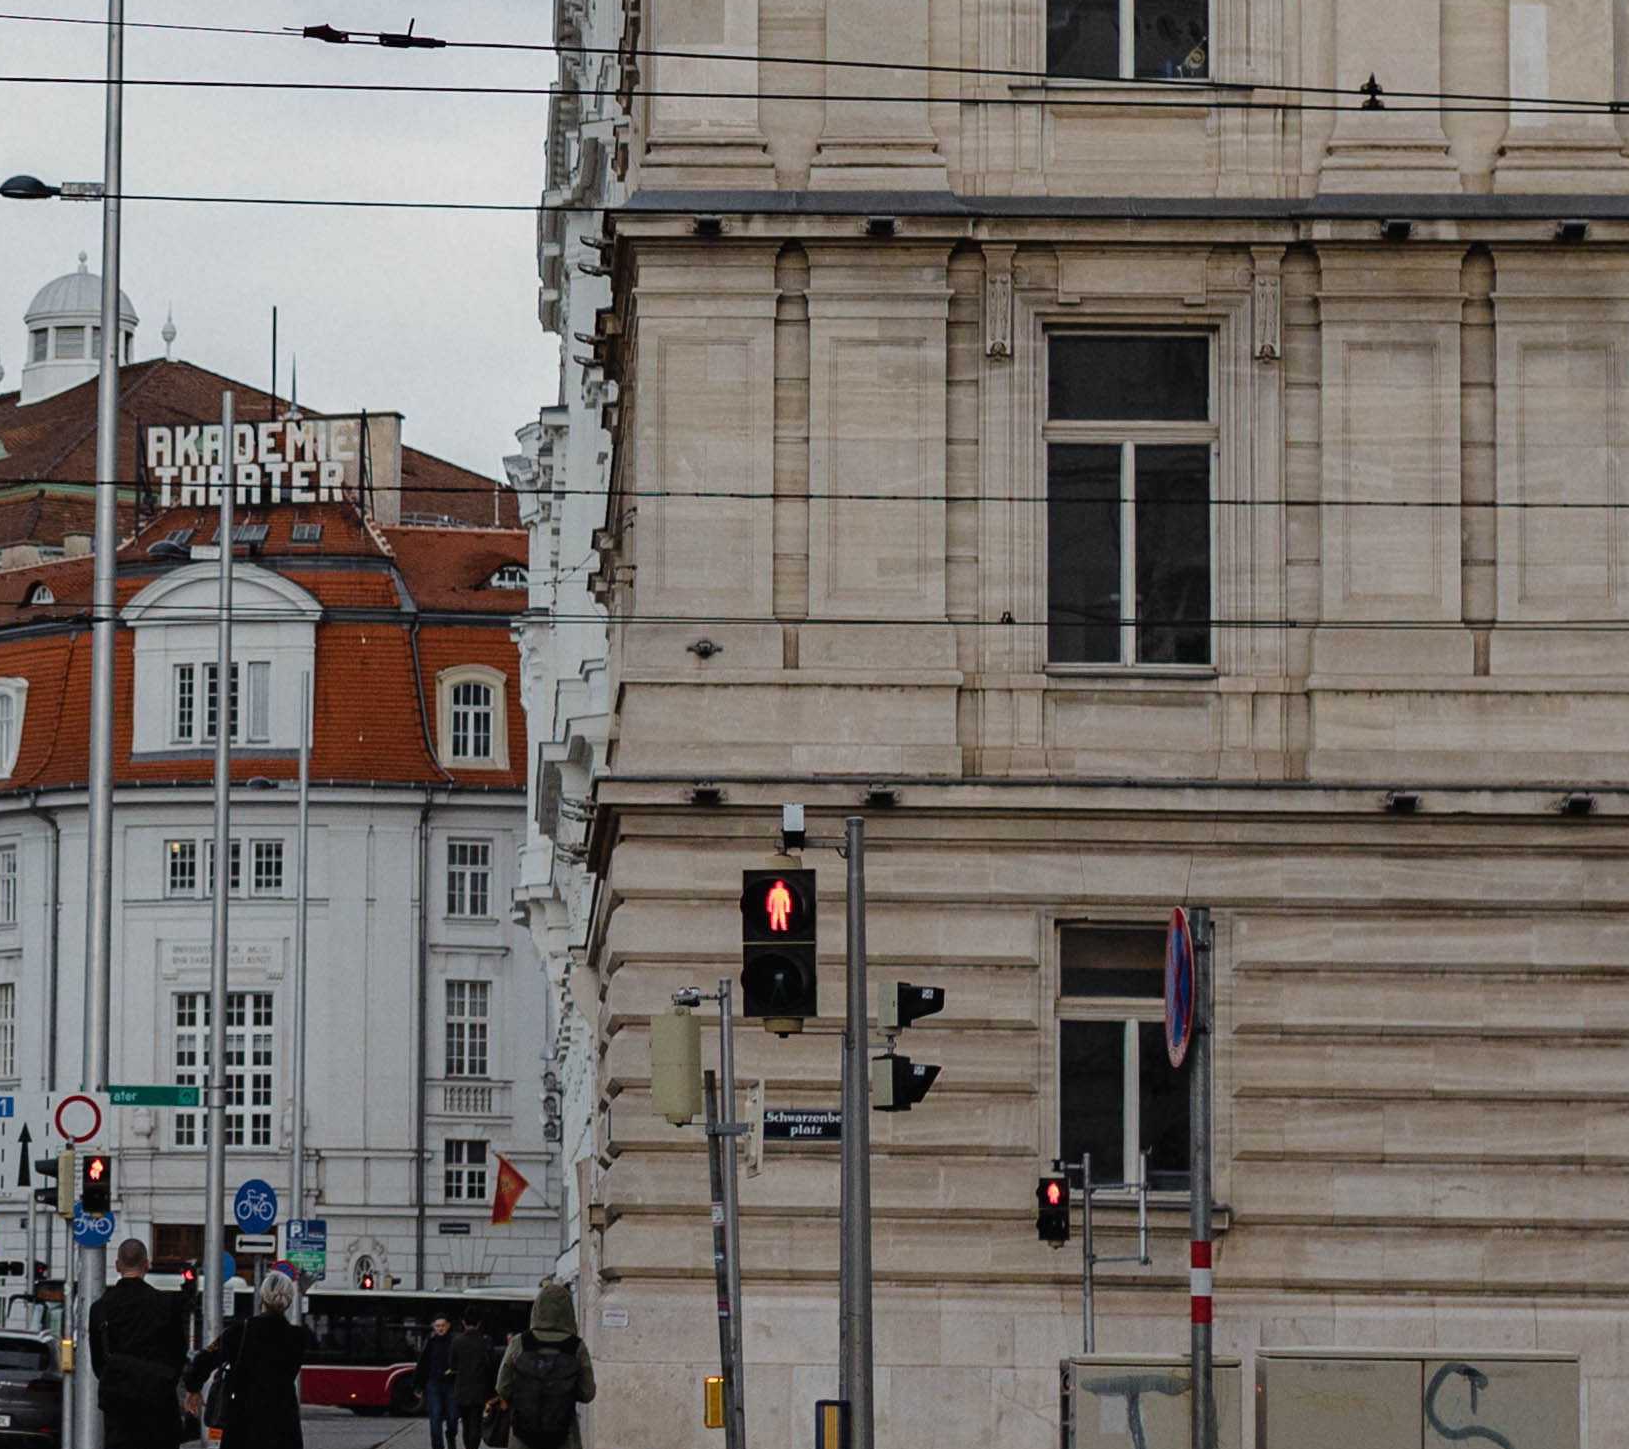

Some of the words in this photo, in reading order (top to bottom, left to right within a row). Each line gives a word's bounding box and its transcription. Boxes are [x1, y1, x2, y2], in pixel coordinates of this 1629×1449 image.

[147, 420, 356, 467] AKADEMIE
[154, 461, 343, 506] THEATER
[0, 1098, 7, 1117] 1
[766, 1111, 841, 1124] Schwarzenbe
[790, 1124, 822, 1137] platz
